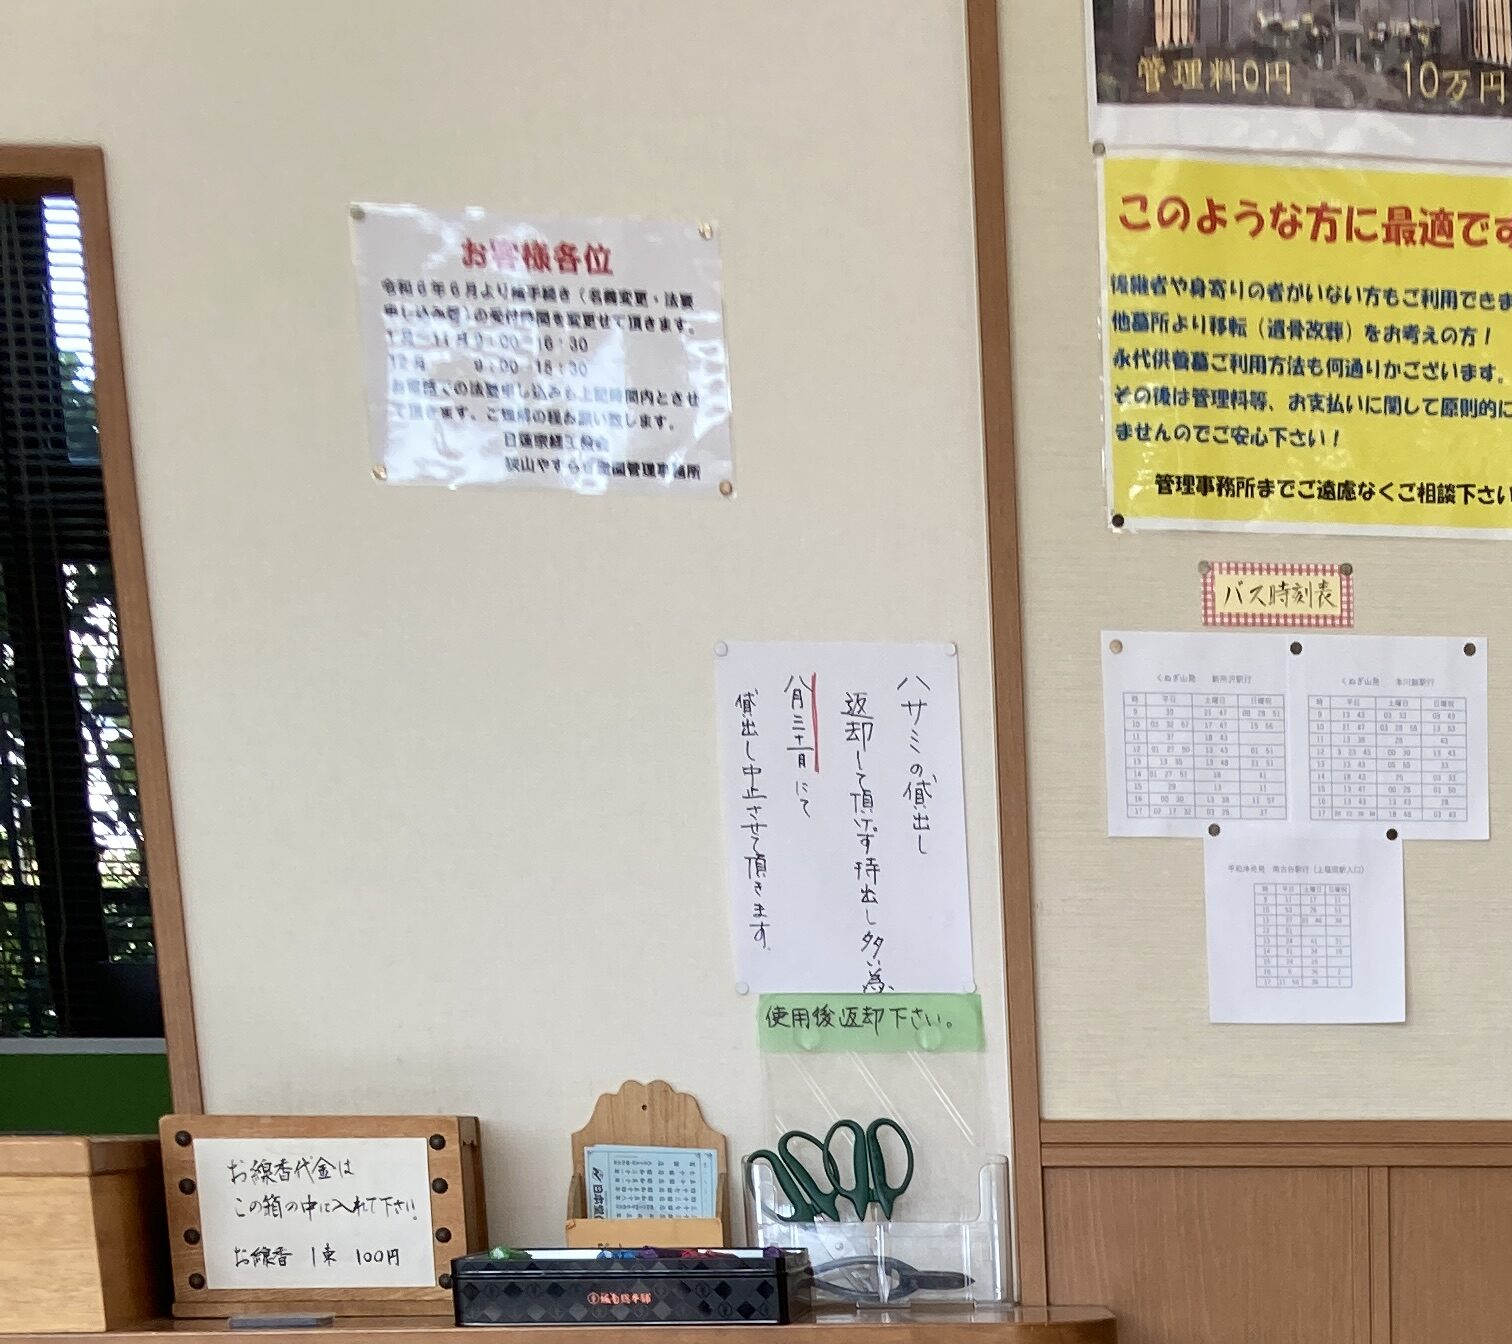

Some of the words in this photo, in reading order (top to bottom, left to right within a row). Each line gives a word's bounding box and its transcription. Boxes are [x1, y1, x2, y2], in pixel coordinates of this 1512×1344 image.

[1223, 580, 1338, 609] バス時刻表
[227, 1155, 355, 1185] お線香代金は
[233, 1246, 293, 1268] お線香
[356, 1248, 400, 1267] 100円
